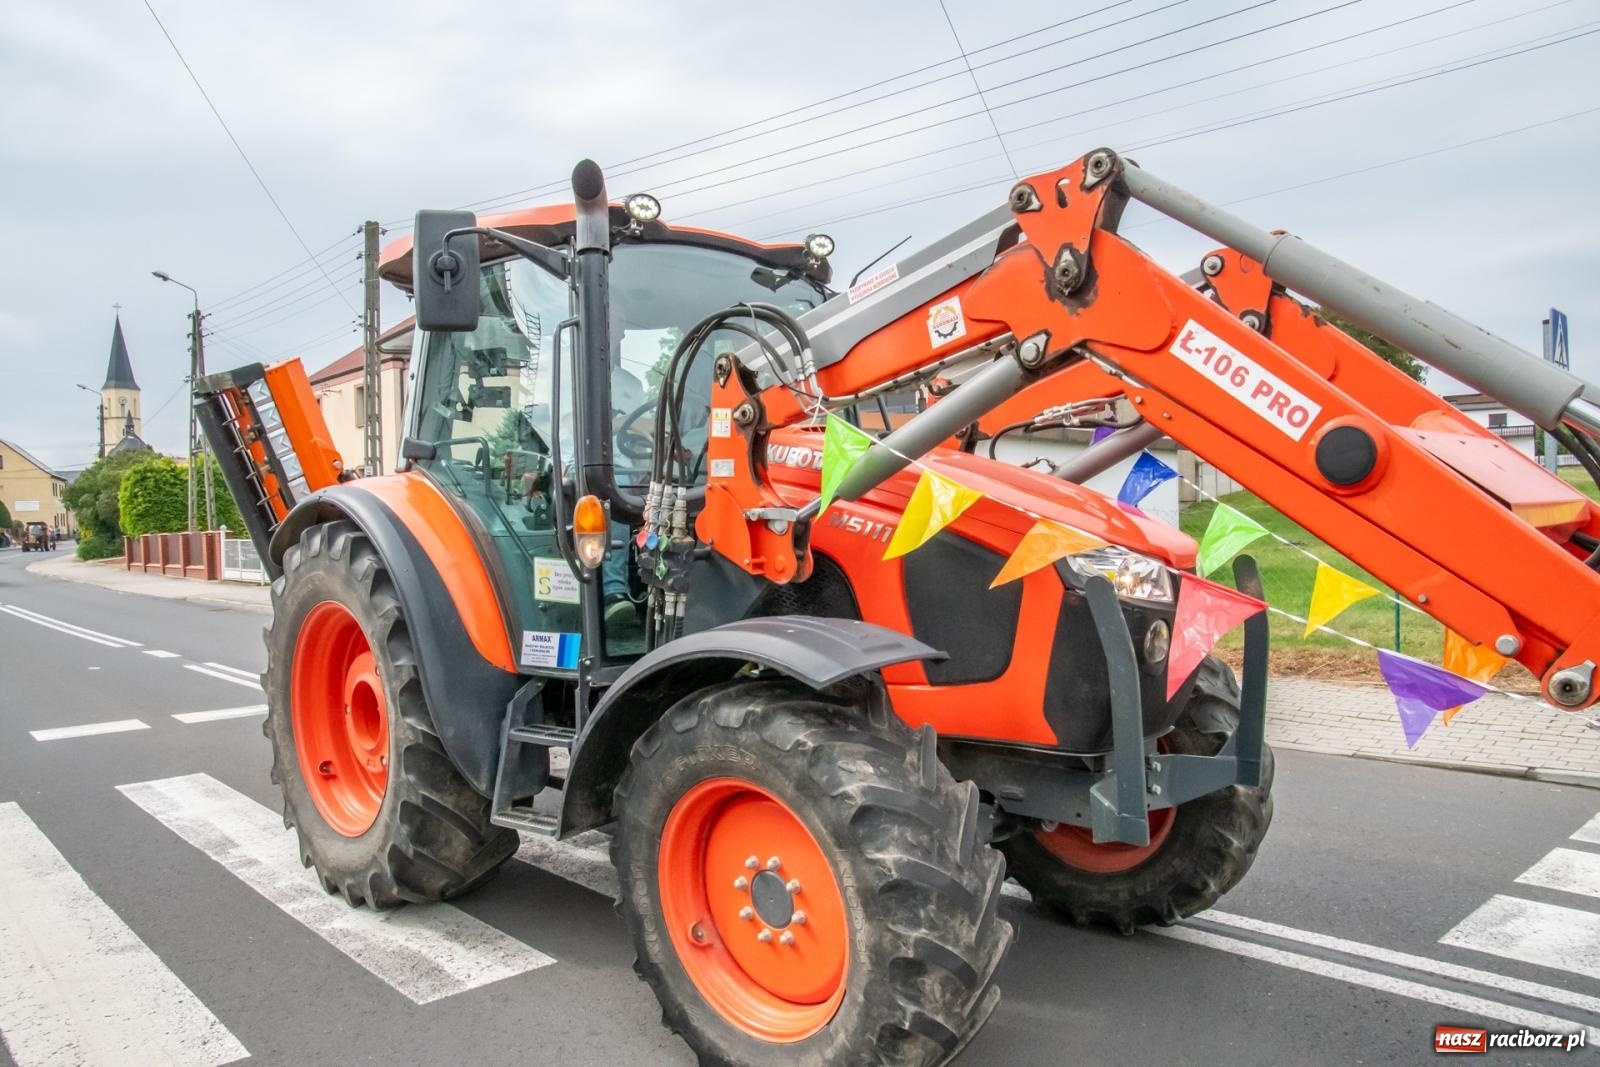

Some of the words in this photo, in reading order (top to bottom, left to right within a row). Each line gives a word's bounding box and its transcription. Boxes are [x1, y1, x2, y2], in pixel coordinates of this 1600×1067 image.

[1179, 330, 1250, 388] Ł-106
[1250, 379, 1309, 428] PRO
[767, 443, 824, 470] KUBOT
[532, 634, 552, 643] ARMAX
